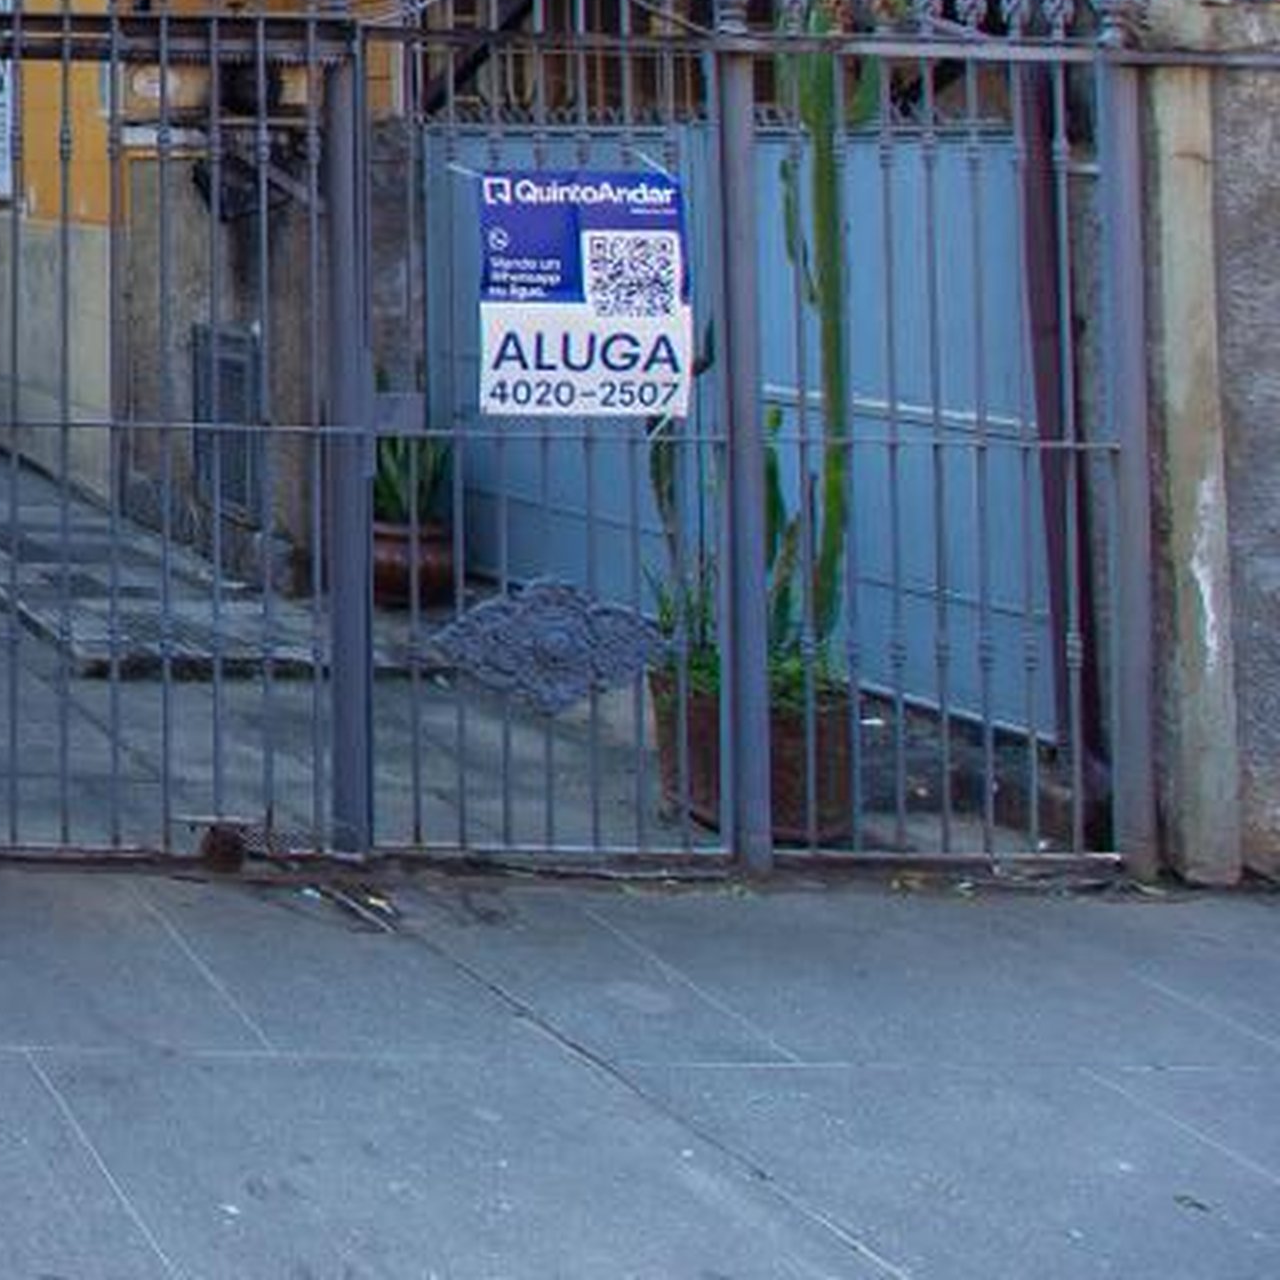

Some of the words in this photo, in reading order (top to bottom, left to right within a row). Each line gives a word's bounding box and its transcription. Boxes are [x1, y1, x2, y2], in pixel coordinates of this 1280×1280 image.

[515, 179, 675, 204] QuintoAndar
[492, 331, 680, 373] ALUGA
[490, 379, 679, 407] 4020-2507
